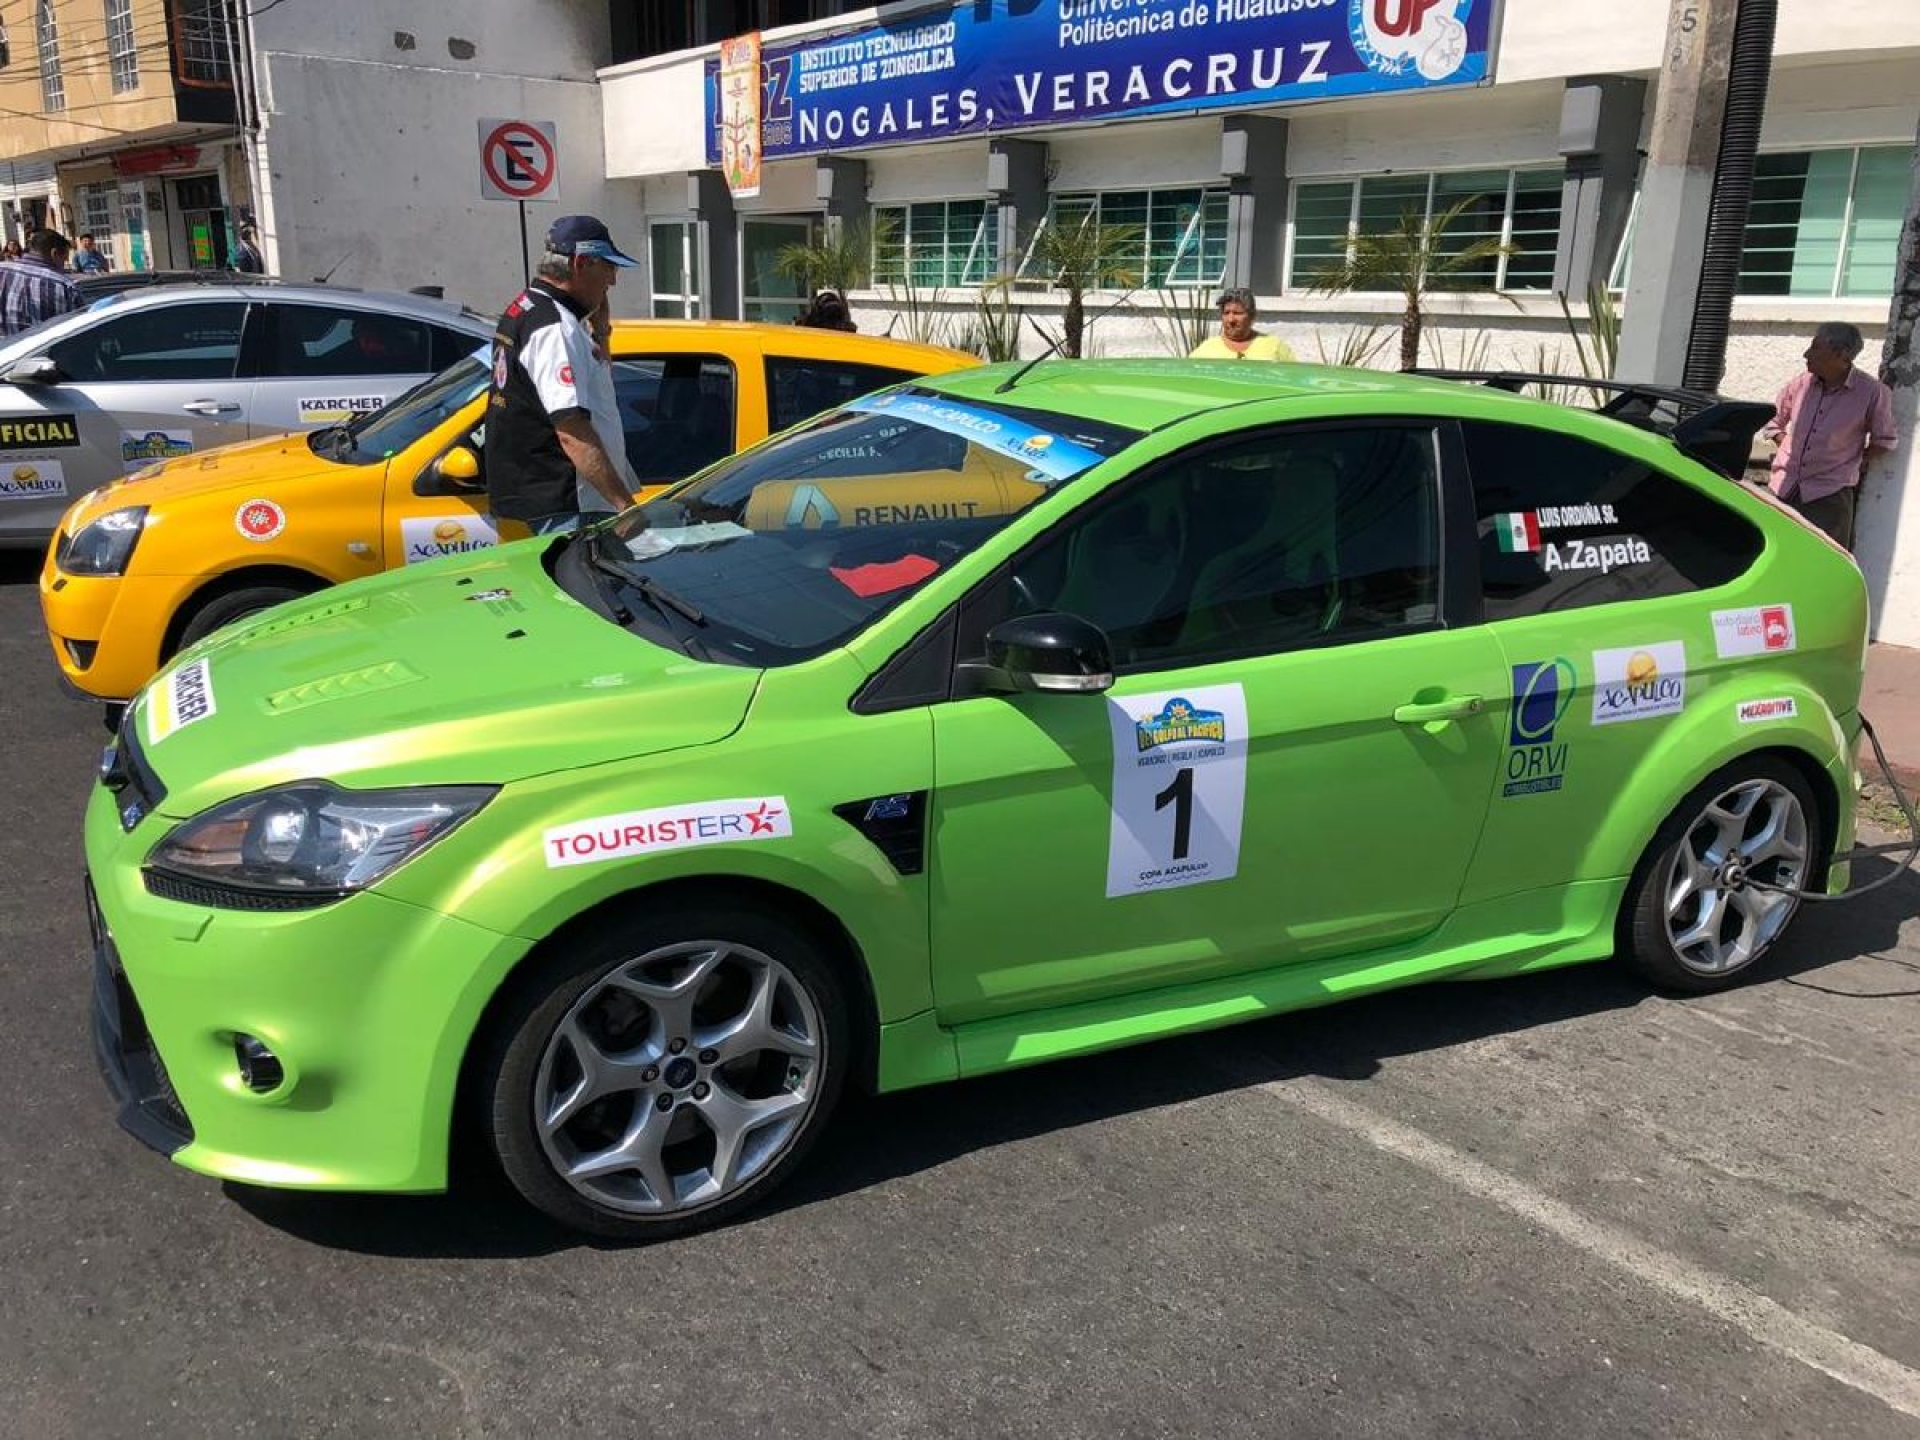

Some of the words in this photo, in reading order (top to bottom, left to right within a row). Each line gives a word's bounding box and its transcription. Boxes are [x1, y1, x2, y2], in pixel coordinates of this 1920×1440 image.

[1058, 9, 1174, 48] Politécnica
[1179, 3, 1209, 27] de
[799, 67, 858, 94] SUPERIOR
[861, 63, 877, 82] DE
[881, 47, 956, 80] ZONGOLICA
[800, 41, 864, 71] INSTITUTO
[506, 140, 535, 182] E
[1536, 507, 1561, 528] LUIS
[1561, 502, 1602, 526] ORDUÑA
[1544, 537, 1651, 574] A.Zapata
[1508, 743, 1569, 780] ORVI
[1155, 767, 1193, 860] 1
[551, 813, 744, 858] TOURISTER
[1139, 868, 1163, 881] COPA
